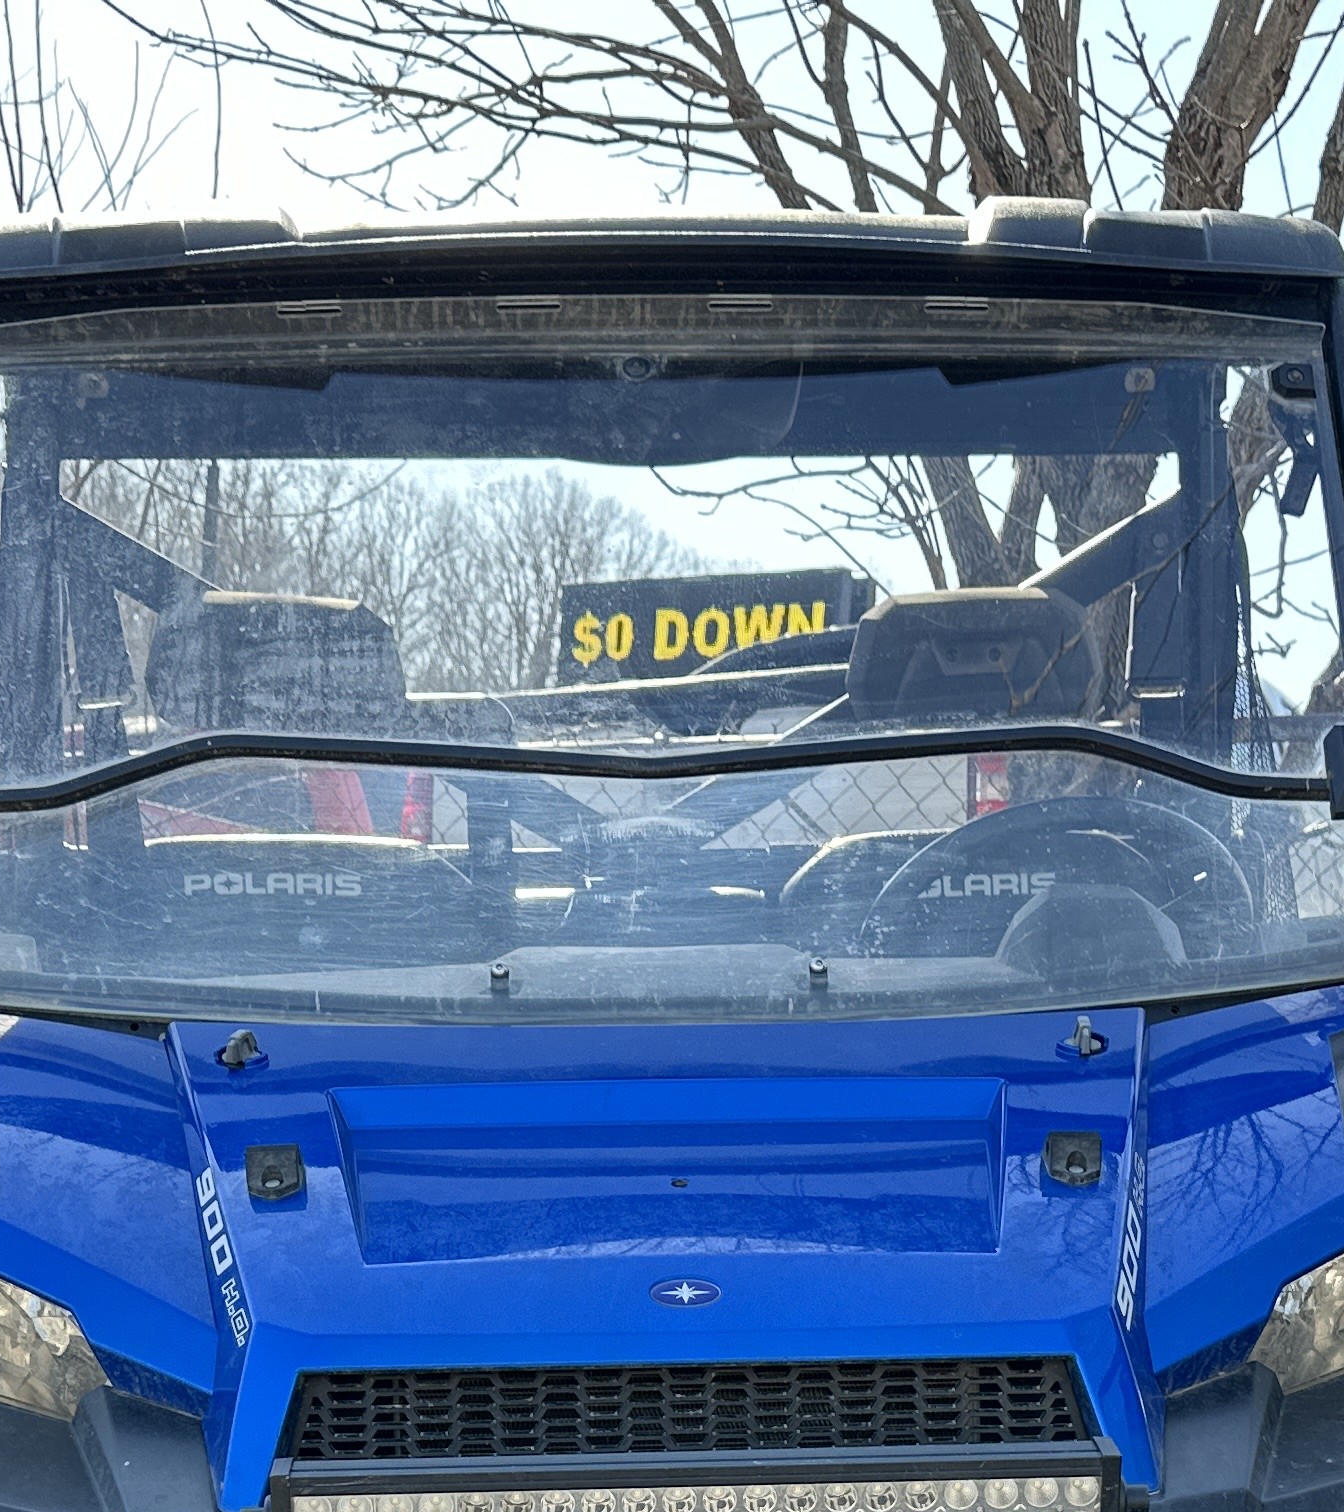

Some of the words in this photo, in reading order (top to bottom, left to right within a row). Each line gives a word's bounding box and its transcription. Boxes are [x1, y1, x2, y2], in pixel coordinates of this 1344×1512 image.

[572, 609, 634, 667] $0
[653, 600, 826, 661] DOWN
[183, 872, 363, 897] POLARIS
[918, 872, 1056, 899] LARIS
[195, 1166, 234, 1277] 900
[220, 1276, 250, 1348] H.O.
[1116, 1199, 1142, 1332] 900
